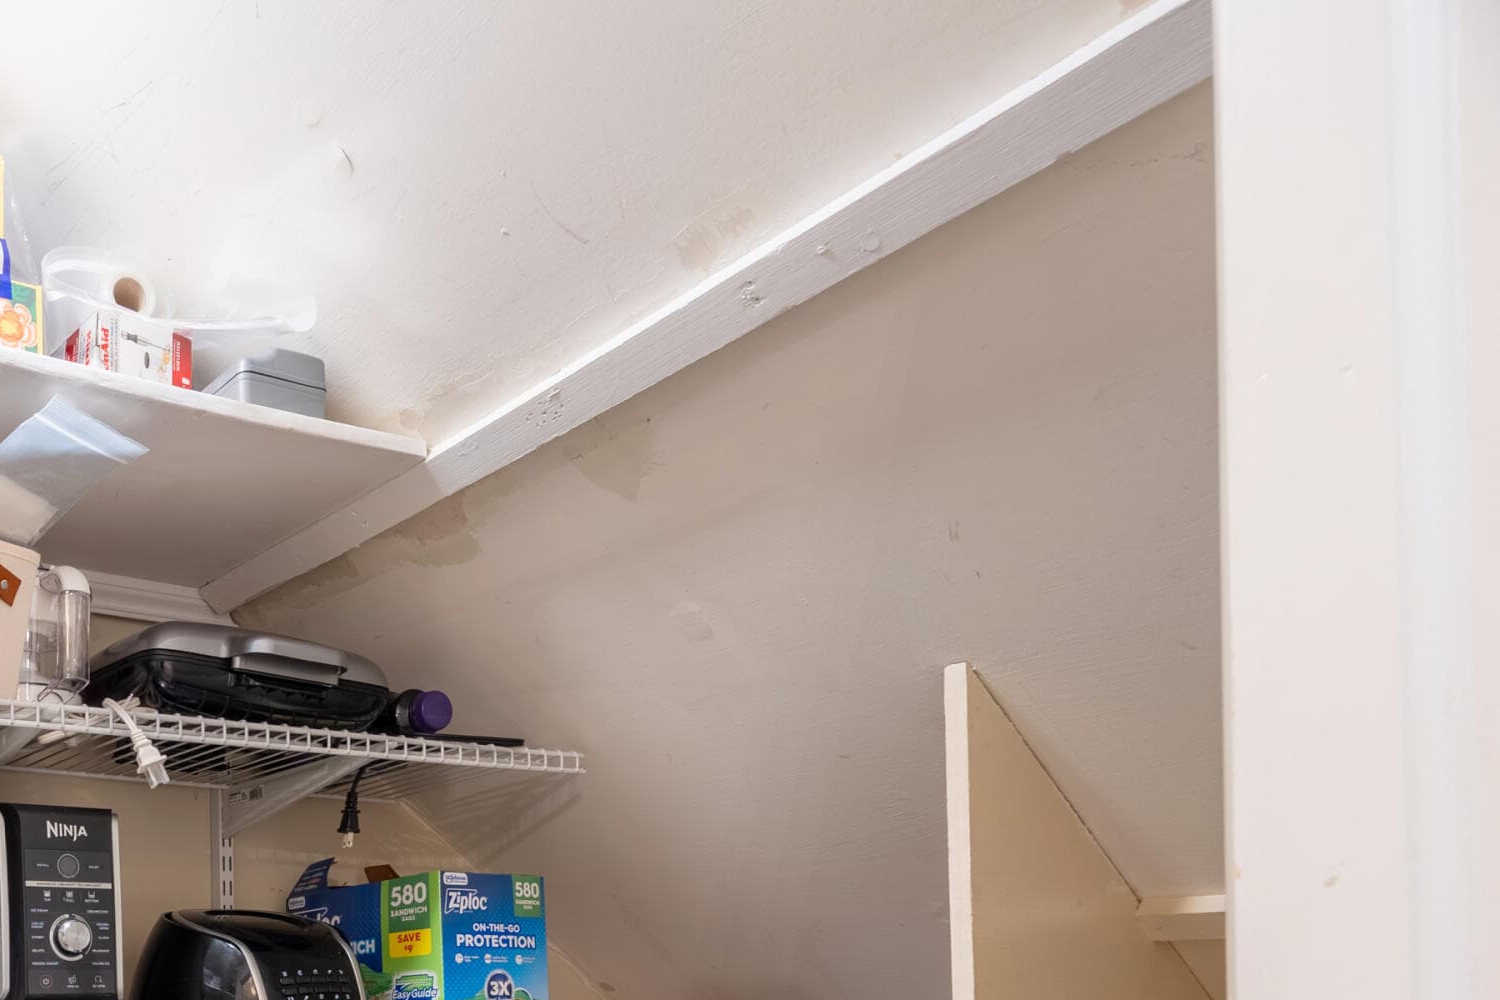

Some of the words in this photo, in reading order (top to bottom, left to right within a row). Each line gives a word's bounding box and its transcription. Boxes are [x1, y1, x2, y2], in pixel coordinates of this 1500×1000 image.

[46, 820, 88, 842] NINJA
[390, 882, 427, 907] 580
[515, 882, 540, 898] 580
[449, 891, 488, 914] Ziploc
[390, 905, 427, 918] SANDWICH
[472, 923, 521, 933] ON-THE-GO
[397, 933, 421, 943] SAVE
[455, 934, 536, 948] PROTECTION
[490, 980, 510, 997] 3X
